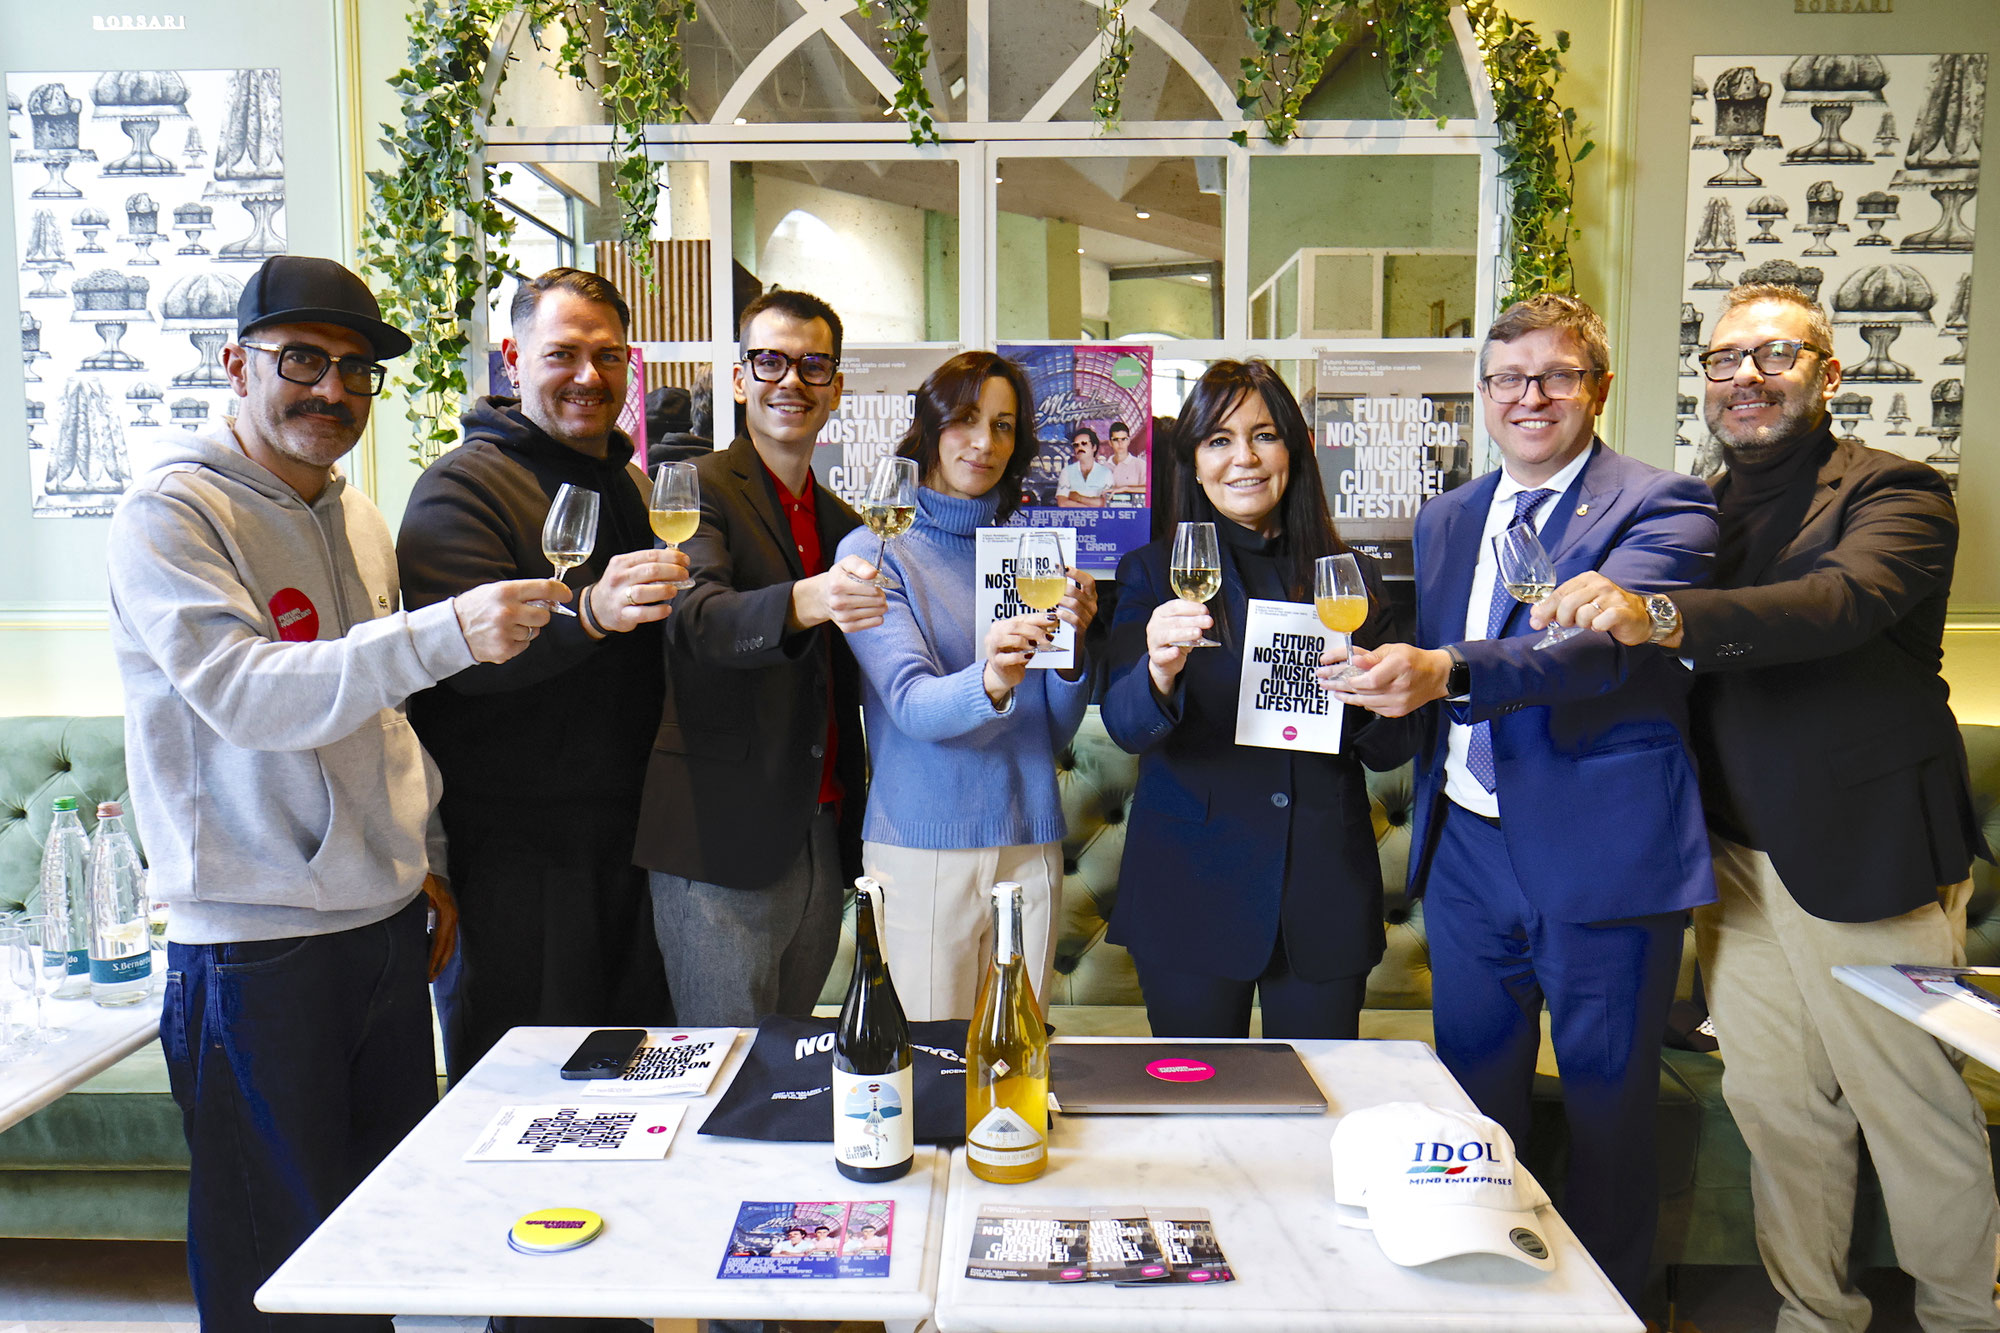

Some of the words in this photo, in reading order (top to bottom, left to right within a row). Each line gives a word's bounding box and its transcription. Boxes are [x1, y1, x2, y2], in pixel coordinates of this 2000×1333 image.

[92, 15, 185, 31] BORSARI
[840, 395, 916, 419] FUTURO
[1353, 398, 1433, 423] FUTURO
[816, 419, 914, 443] NOSTALGI
[1325, 422, 1459, 447] NOSTALGICO!
[1354, 446, 1428, 471] MUSIC!
[1339, 469, 1444, 495] CULTURE!
[1032, 510, 1099, 519] ENTERPRISES
[1102, 511, 1115, 519] DJ
[1118, 511, 1137, 519] SET
[1334, 494, 1430, 518] LIFESTYL
[1030, 519, 1049, 527] OFF
[1052, 519, 1066, 527] BY
[1272, 632, 1325, 652] FUTURO
[1271, 664, 1319, 683] MUSIC!
[1260, 678, 1328, 700] CULTURE!
[1255, 694, 1329, 716] LIFESTYLE!
[623, 1070, 685, 1080] FUTURO
[517, 1117, 553, 1144] FUTURO
[532, 1108, 580, 1153] NOSTALGICO!
[560, 1118, 594, 1143] MUSIC!
[578, 1112, 617, 1148] CULTURE!
[598, 1112, 638, 1149] LIFESTYLE!
[1412, 1141, 1501, 1163] IDOL
[1409, 1177, 1441, 1185] MIND
[1445, 1177, 1512, 1186] ENTERPRISES
[982, 1226, 1079, 1238] NOSTALGICO!
[1003, 1219, 1060, 1230] FUTURO
[984, 1251, 1070, 1262] LIFESTYLE!
[990, 1243, 1068, 1253] CULTURE!
